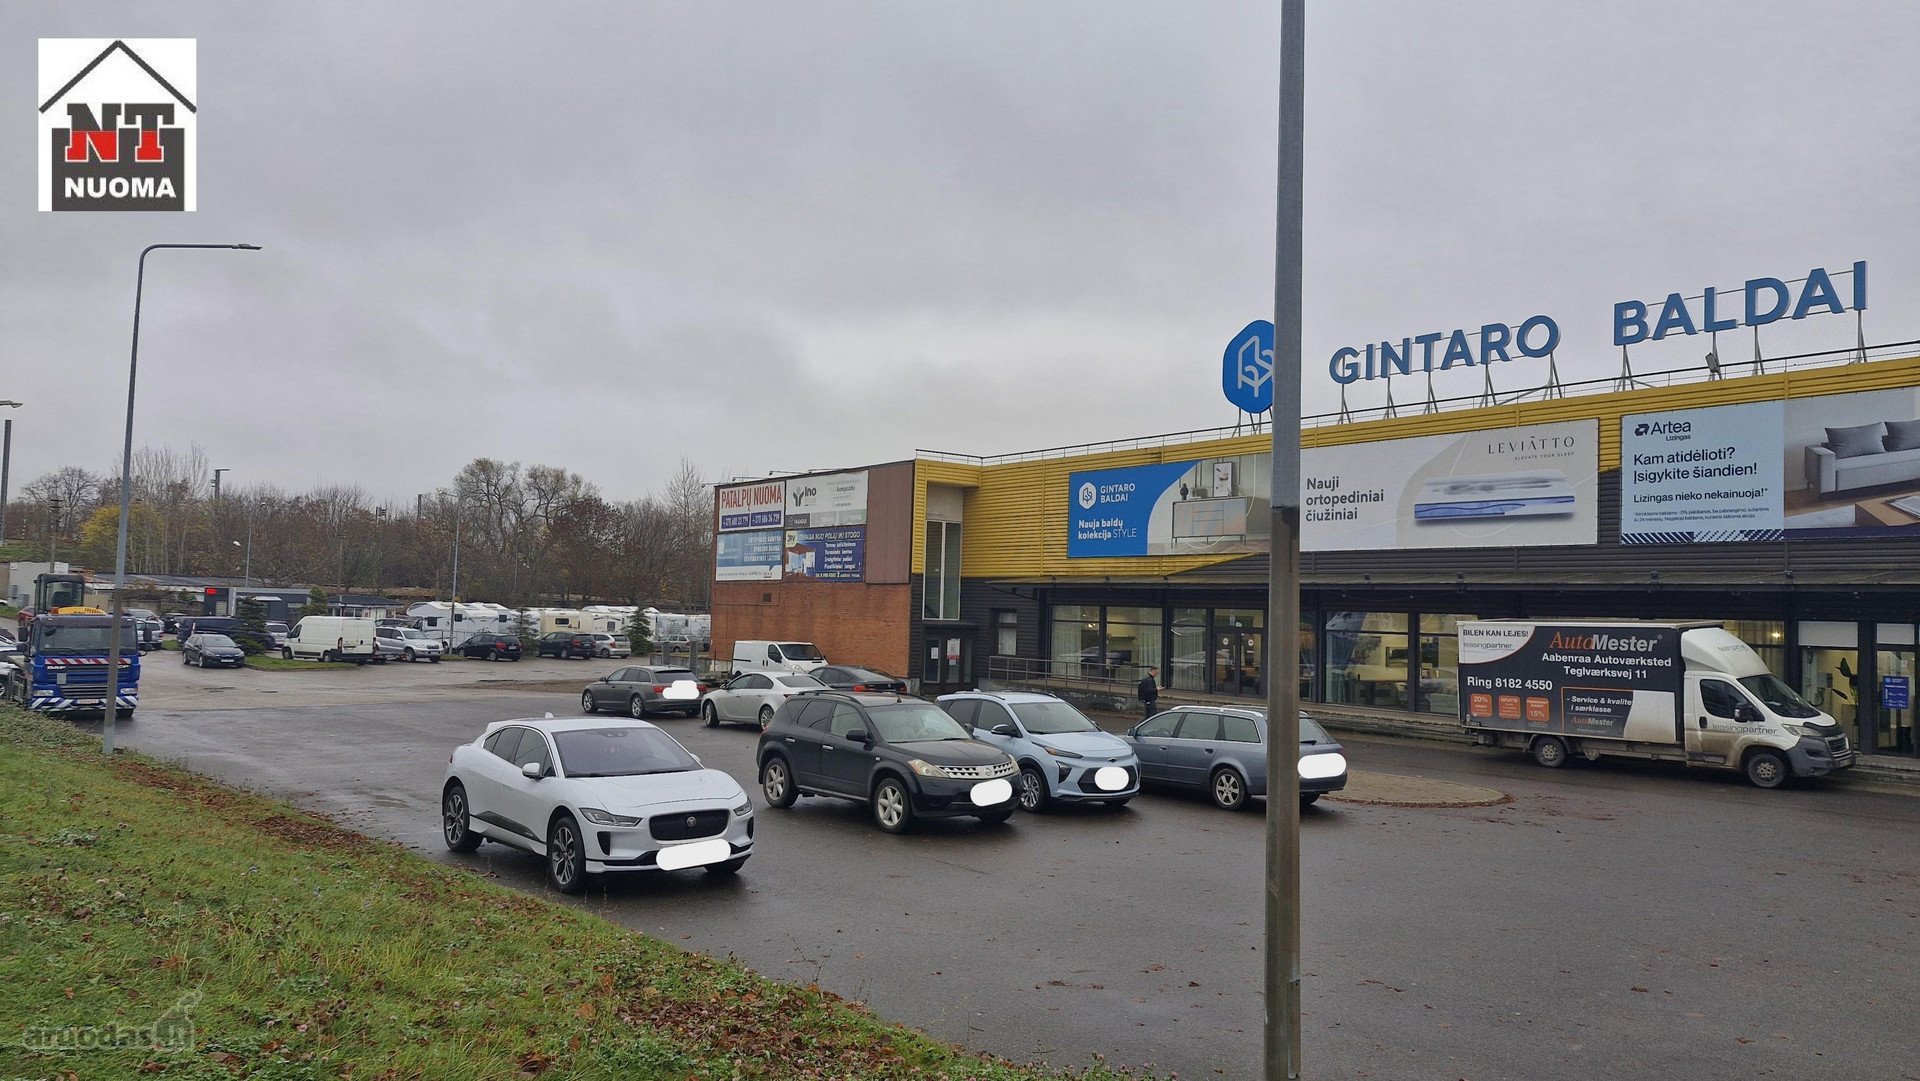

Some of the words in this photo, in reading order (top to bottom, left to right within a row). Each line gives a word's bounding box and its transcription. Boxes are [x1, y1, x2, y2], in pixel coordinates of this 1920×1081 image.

[1329, 315, 1561, 385] GINTARO
[1613, 260, 1868, 347] BALDAI
[1651, 421, 1691, 435] Artea
[1665, 434, 1692, 442] Lizingas
[1634, 453, 1664, 466] Kam
[1667, 446, 1736, 464] atidėlioti?
[1634, 466, 1690, 484] Įsigykite
[1693, 462, 1758, 479] šiandien!
[1100, 483, 1136, 494] GINTARO
[1306, 475, 1339, 492] Nauji
[721, 488, 752, 511] PATALPŲ
[753, 485, 782, 506] NUOMA
[1100, 493, 1129, 503] BALDAI
[1306, 489, 1384, 508] ortopediniai
[1634, 493, 1674, 504] Lizingas
[1675, 491, 1703, 501] nieko
[1306, 507, 1357, 521] čiužiniai
[1078, 518, 1100, 530] Nauja
[1101, 518, 1124, 529] baldų
[1078, 529, 1112, 541] kolekcija
[1112, 528, 1137, 538] STYLE
[1463, 629, 1484, 637] BILEN
[1503, 630, 1529, 638] LEJES!
[1463, 641, 1513, 650] leasingpartner
[1542, 652, 1591, 664] Aabenraa
[1593, 655, 1672, 667] Autoværksted
[1563, 666, 1632, 680] Teglværksvej
[1635, 669, 1647, 679] 11
[1467, 676, 1492, 689] Ring
[1495, 677, 1523, 689] 8182
[1525, 679, 1553, 691] 4550
[1473, 695, 1489, 703] 20%
[1571, 695, 1599, 704] Service
[1607, 697, 1634, 706] kvalite
[1530, 709, 1545, 718] 15%
[1574, 705, 1612, 713] særklasse
[1712, 723, 1778, 735] leasingpartner
